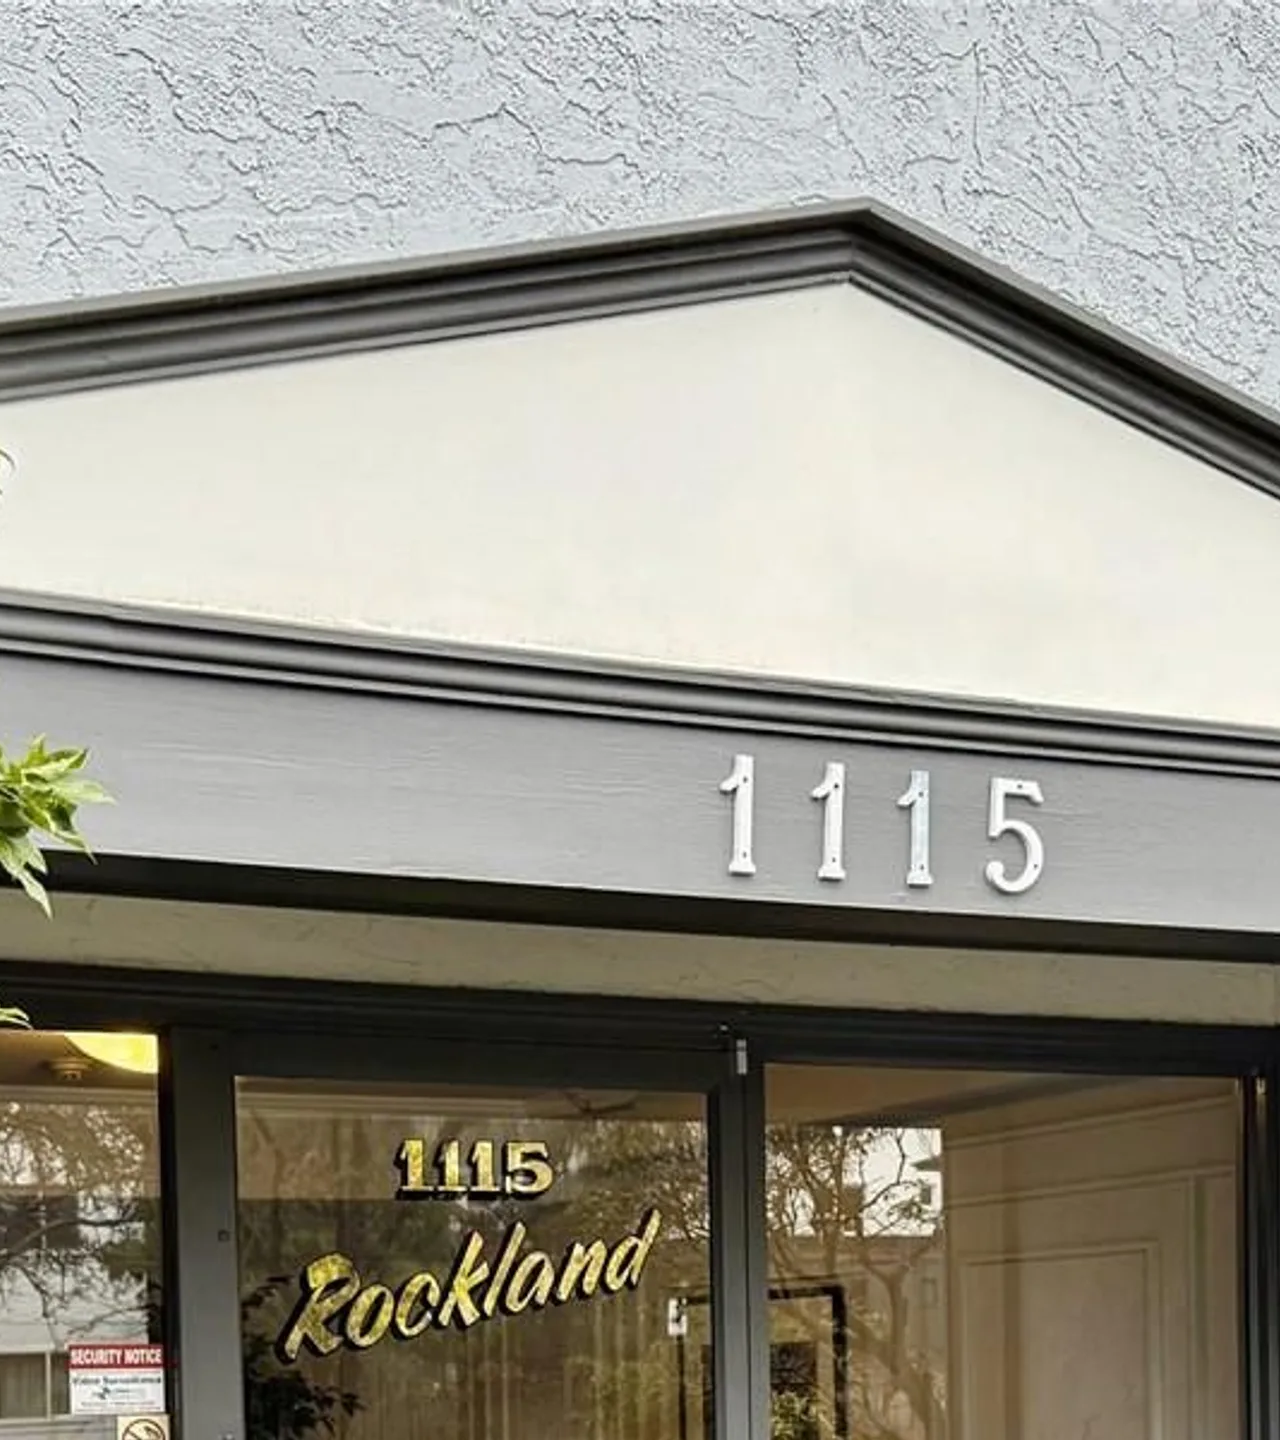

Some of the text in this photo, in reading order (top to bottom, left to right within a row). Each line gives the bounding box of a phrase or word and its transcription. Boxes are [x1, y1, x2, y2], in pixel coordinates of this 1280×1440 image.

[718, 753, 1046, 895] 1115
[394, 1138, 556, 1201] 1115
[276, 1207, 663, 1362] Rockland
[71, 1348, 161, 1364] SECURITY NOTICE
